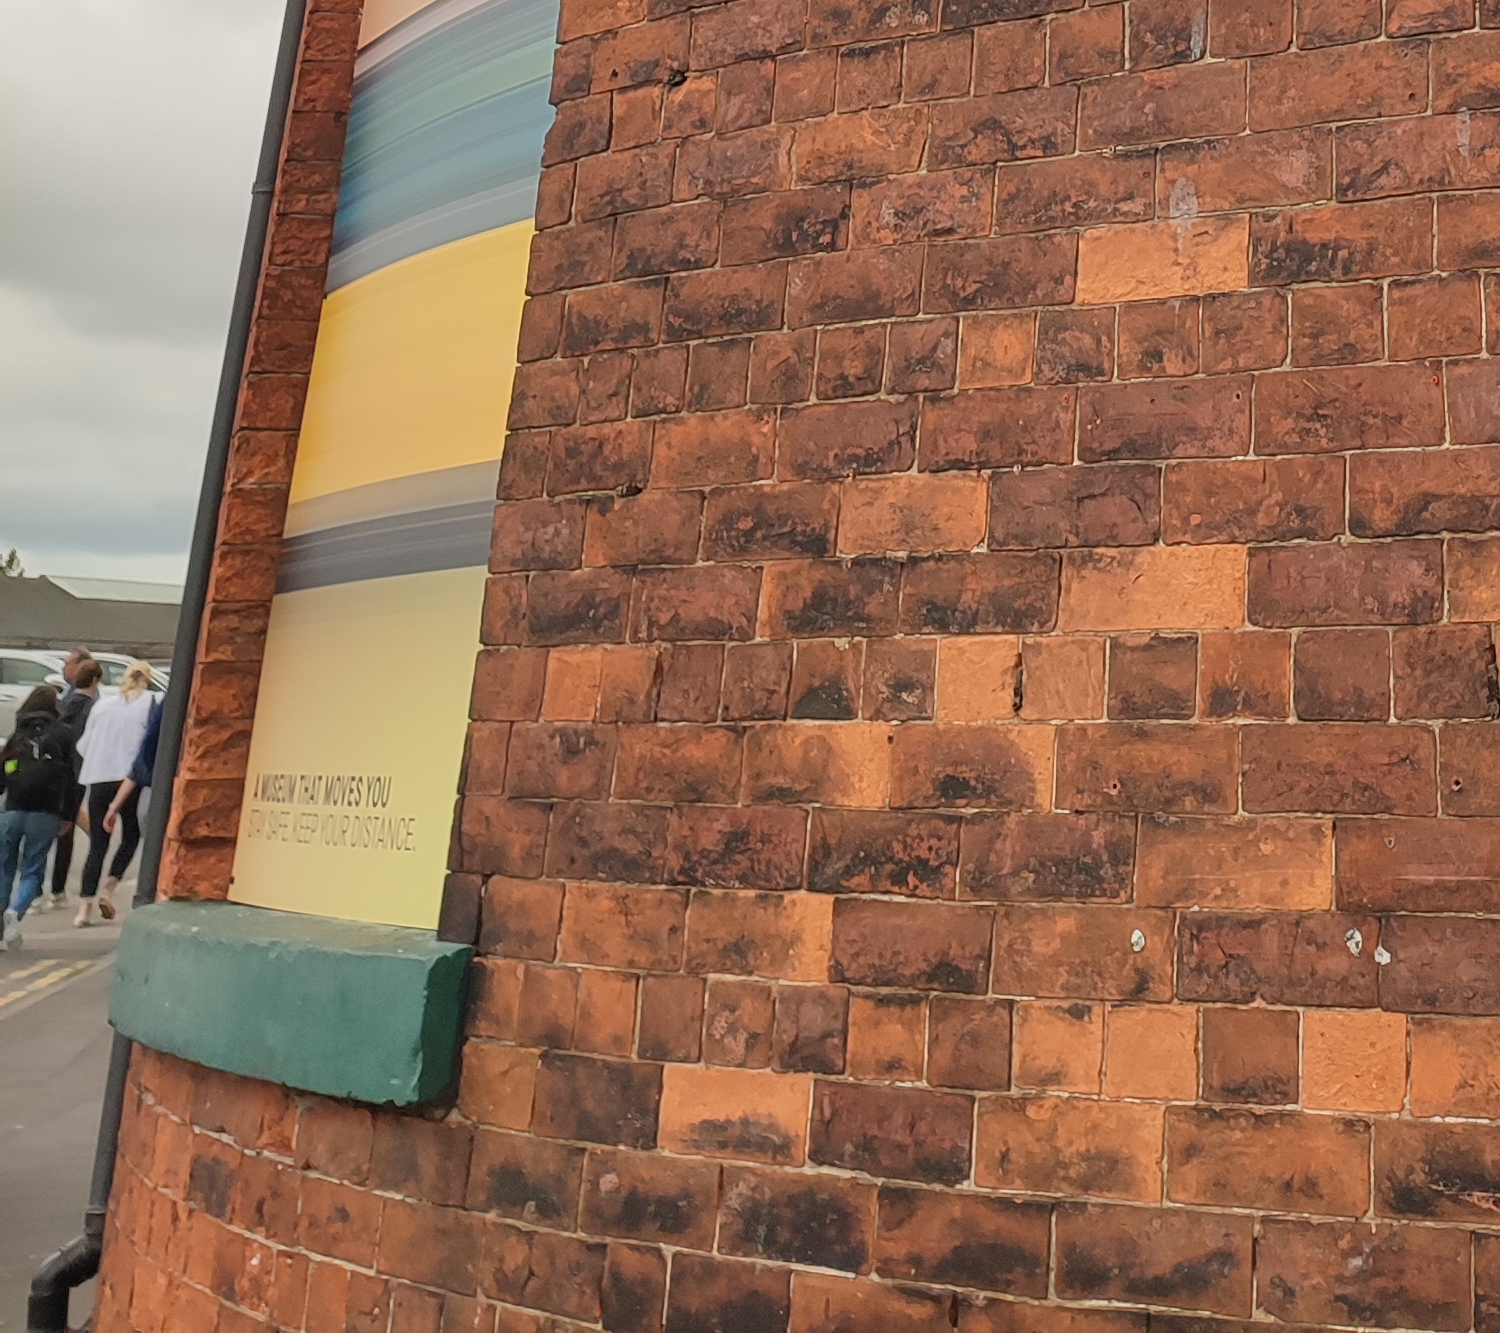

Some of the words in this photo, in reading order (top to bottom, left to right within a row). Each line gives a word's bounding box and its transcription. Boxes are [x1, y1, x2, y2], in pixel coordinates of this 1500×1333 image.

[251, 773, 261, 801] A
[297, 774, 323, 806] THAT
[322, 774, 364, 808] MOVES
[365, 775, 393, 809] YOU
[350, 814, 417, 852] DISTANCE.
